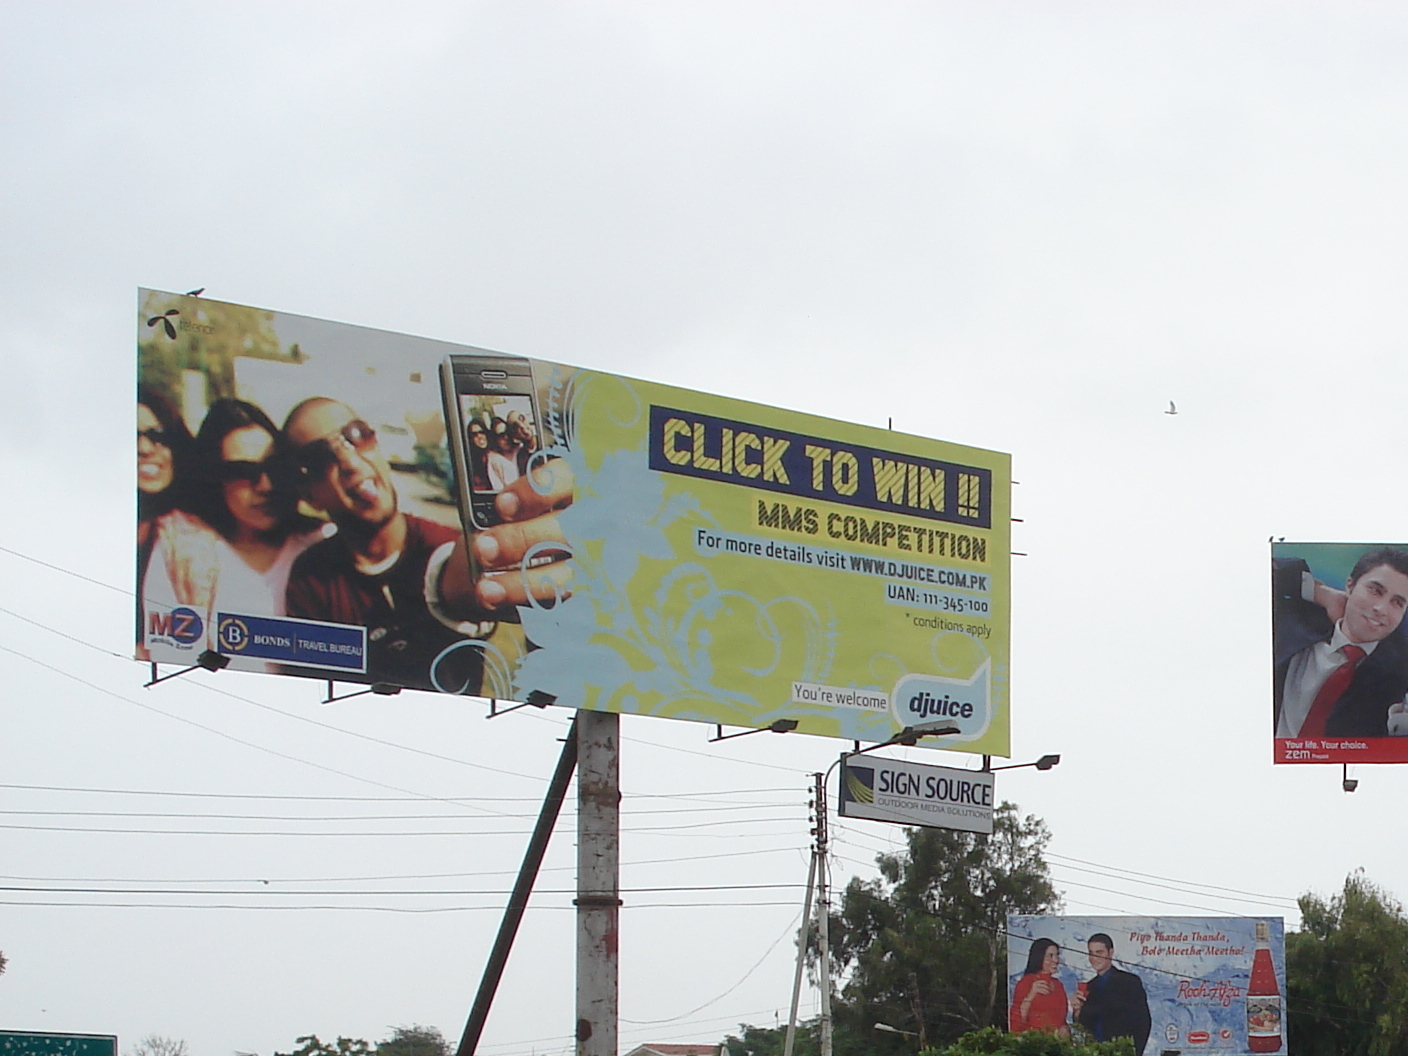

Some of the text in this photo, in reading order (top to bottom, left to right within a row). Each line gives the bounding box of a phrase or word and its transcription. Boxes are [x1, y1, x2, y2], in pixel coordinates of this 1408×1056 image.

[664, 418, 790, 485] CLICK
[805, 444, 859, 496] TO
[872, 457, 945, 512] WIN
[758, 500, 986, 563] MMS COMPETITION
[697, 530, 987, 591] For more details visit WWW.DJUICE.COM.PK
[888, 584, 988, 612] UAN: 111-345-100
[913, 615, 992, 640] conditions apply
[253, 634, 362, 656] BONDS TRAVEL BUREAU
[794, 684, 887, 709] You're welcome
[909, 692, 974, 719] djuice
[1285, 741, 1368, 749] Your life. Your choice.
[1285, 750, 1310, 759] zem
[879, 770, 992, 806] SIGN SOURCE
[877, 798, 992, 819] OUTDOOR MEDIA SOLUTIONS
[1154, 932, 1188, 942] Thanda
[1192, 932, 1230, 942] Thanda,
[1141, 946, 1245, 956] Bolo Meetha Meetha!
[1177, 980, 1206, 999] Rooh
